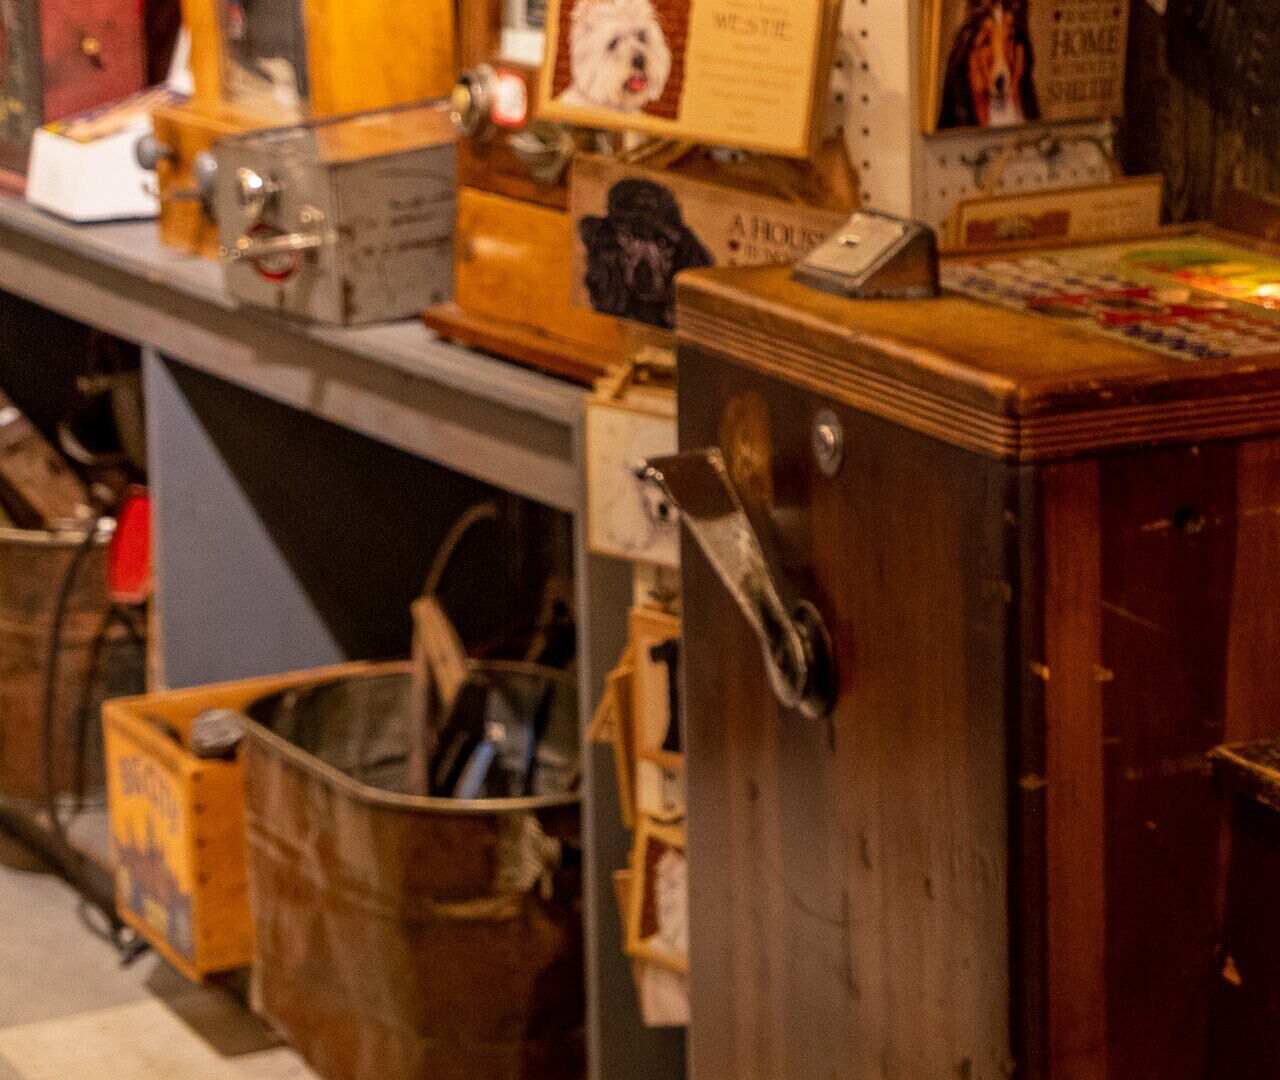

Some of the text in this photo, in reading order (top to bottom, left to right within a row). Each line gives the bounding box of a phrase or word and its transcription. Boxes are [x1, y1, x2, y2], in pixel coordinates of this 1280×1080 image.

[712, 11, 793, 42] WESTIE
[730, 214, 827, 249] A HOUS
